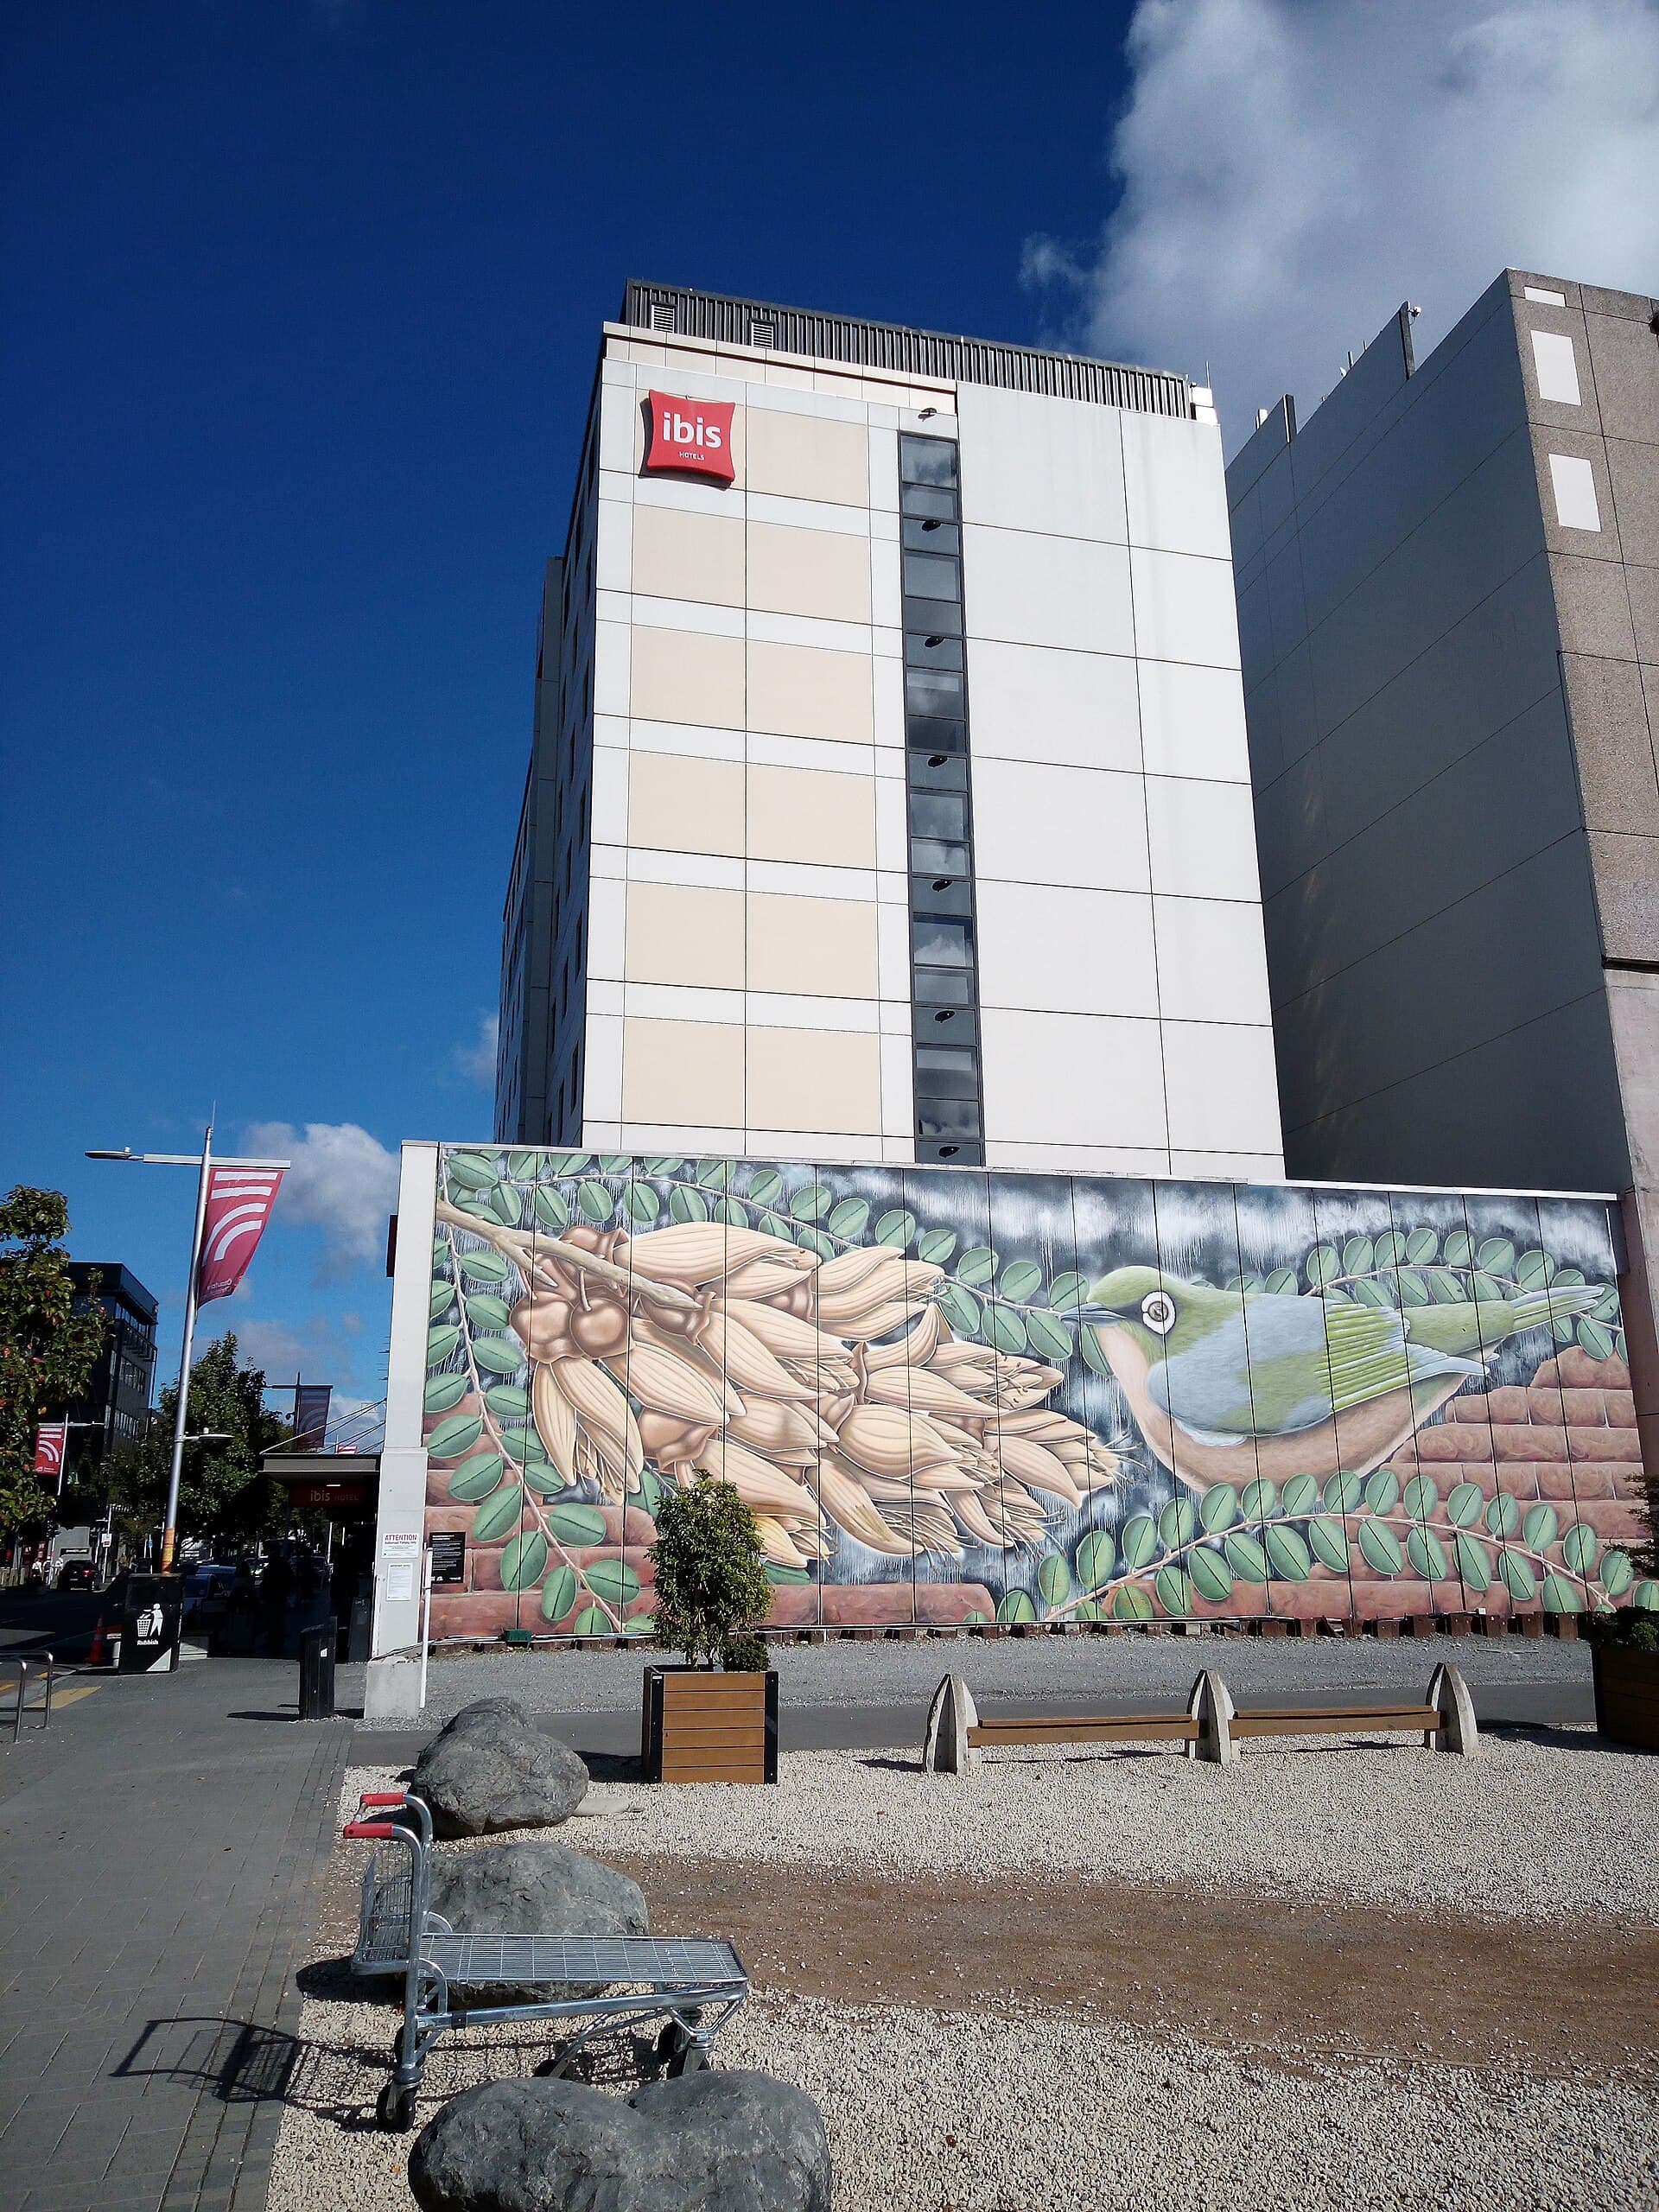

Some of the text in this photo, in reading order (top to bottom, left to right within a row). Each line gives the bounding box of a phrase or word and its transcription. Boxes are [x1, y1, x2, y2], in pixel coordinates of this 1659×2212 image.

[663, 411, 722, 448] ibis
[678, 451, 706, 461] HOTELS
[310, 1490, 331, 1502] ibis
